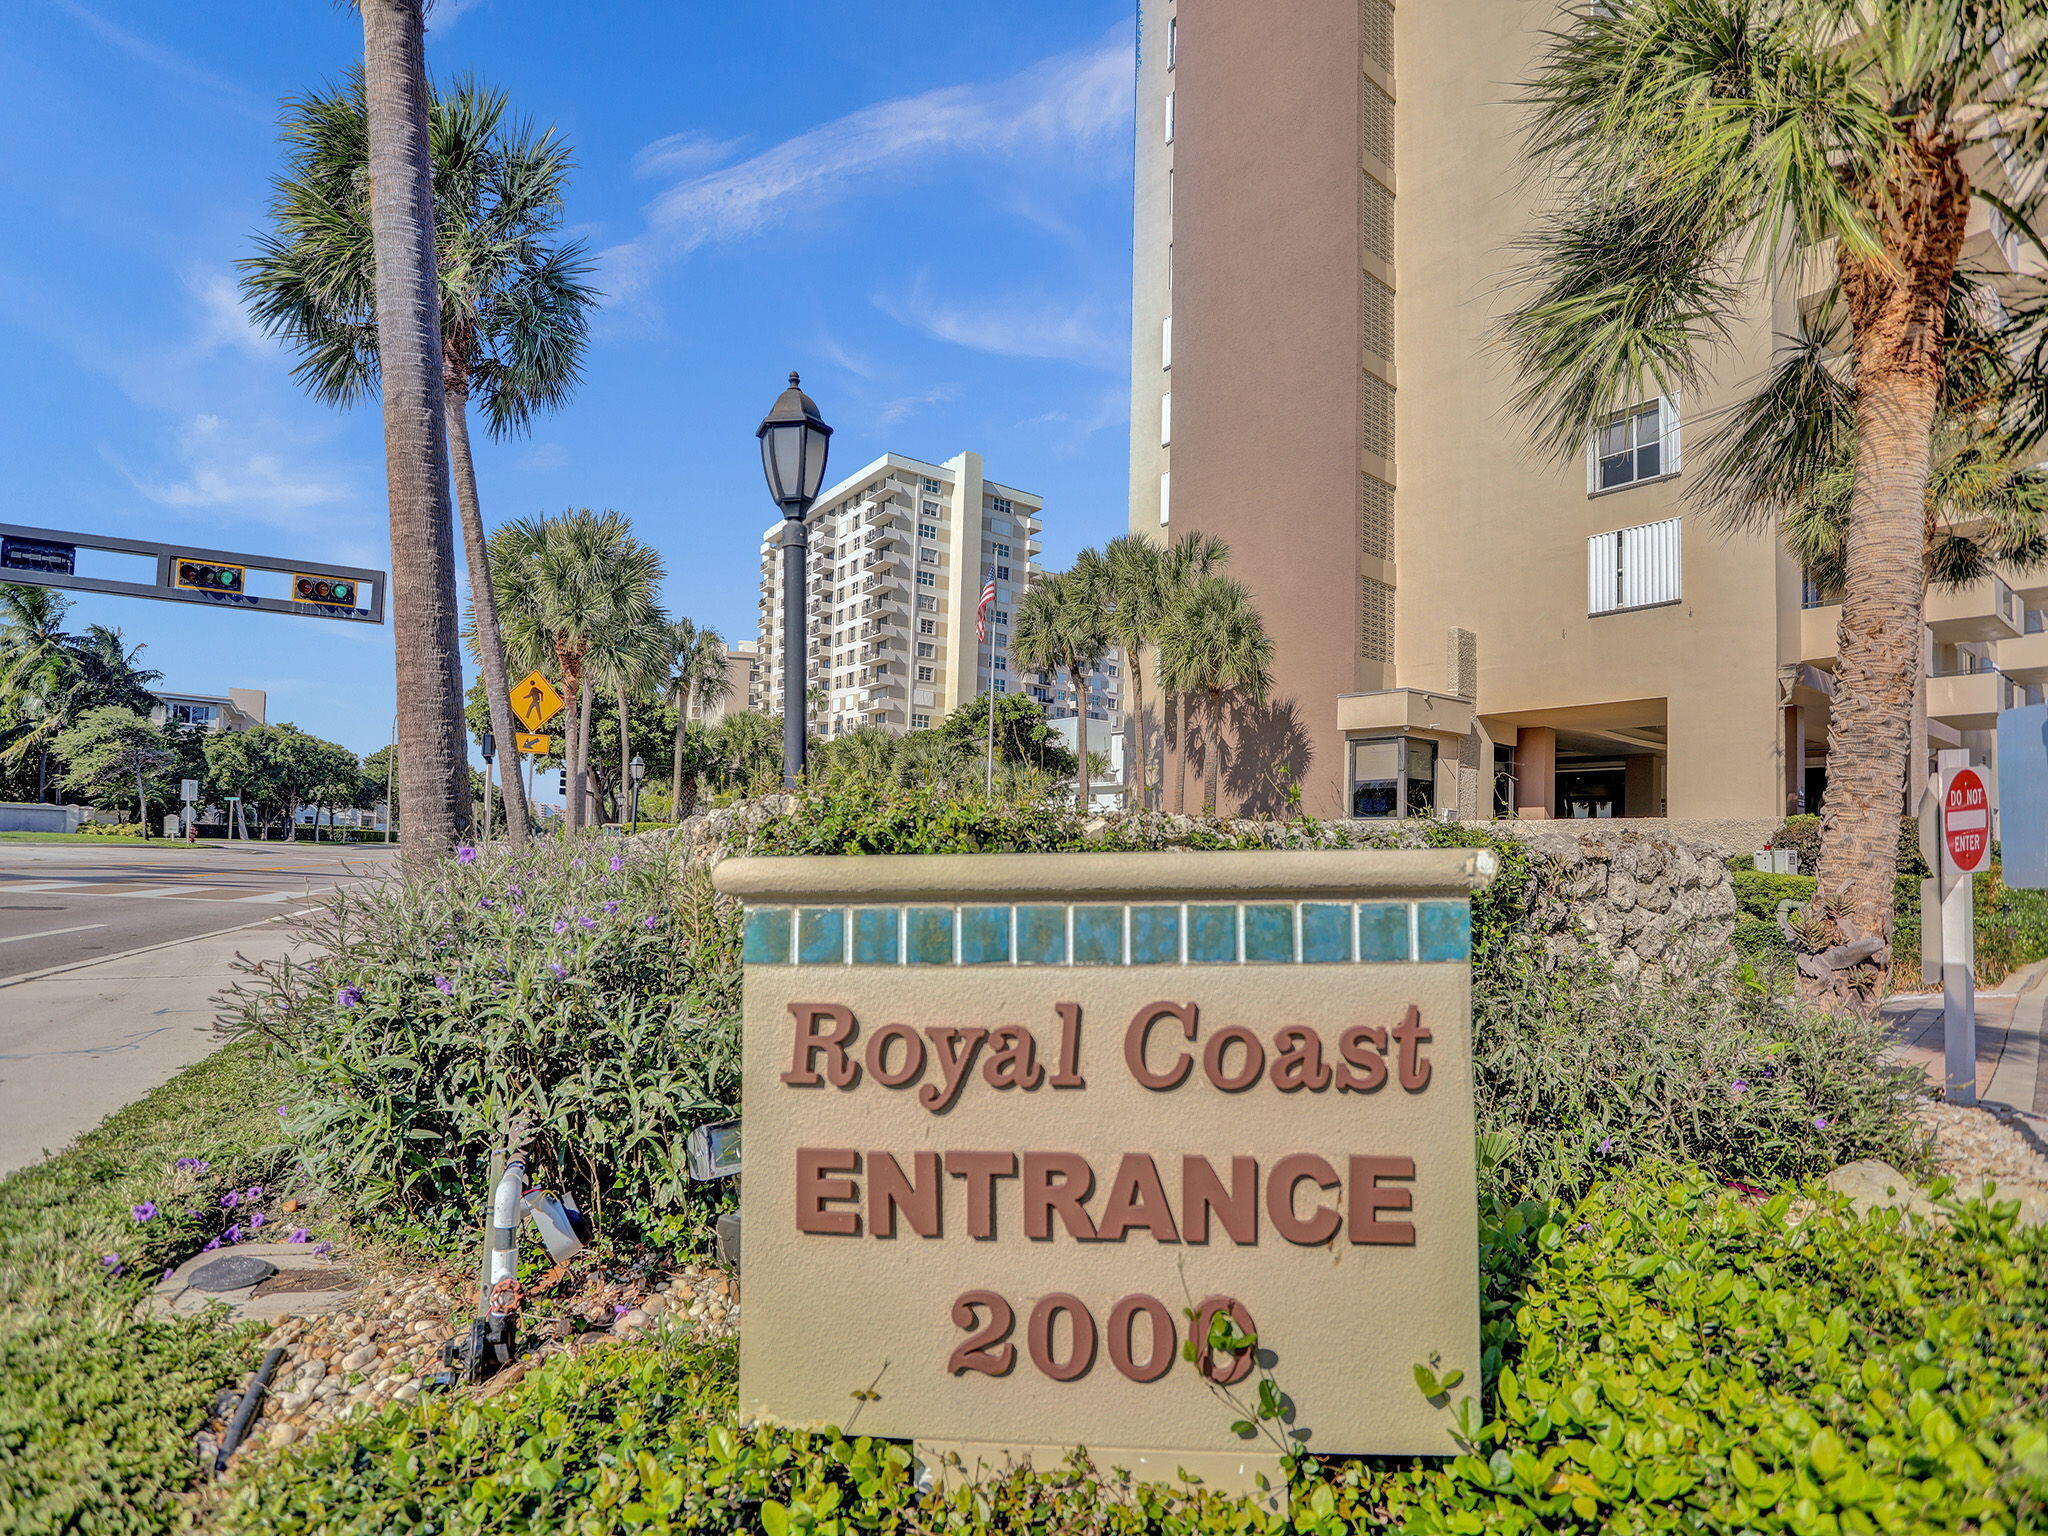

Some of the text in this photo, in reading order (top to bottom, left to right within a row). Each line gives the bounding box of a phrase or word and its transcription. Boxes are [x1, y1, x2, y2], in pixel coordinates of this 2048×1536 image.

[1950, 787, 1983, 807] DO NOT
[1954, 834, 1980, 852] ENTER
[781, 1001, 1432, 1114] Royal Coast
[795, 1147, 1415, 1247] ENTRANCE
[946, 1289, 1258, 1385] 2000
